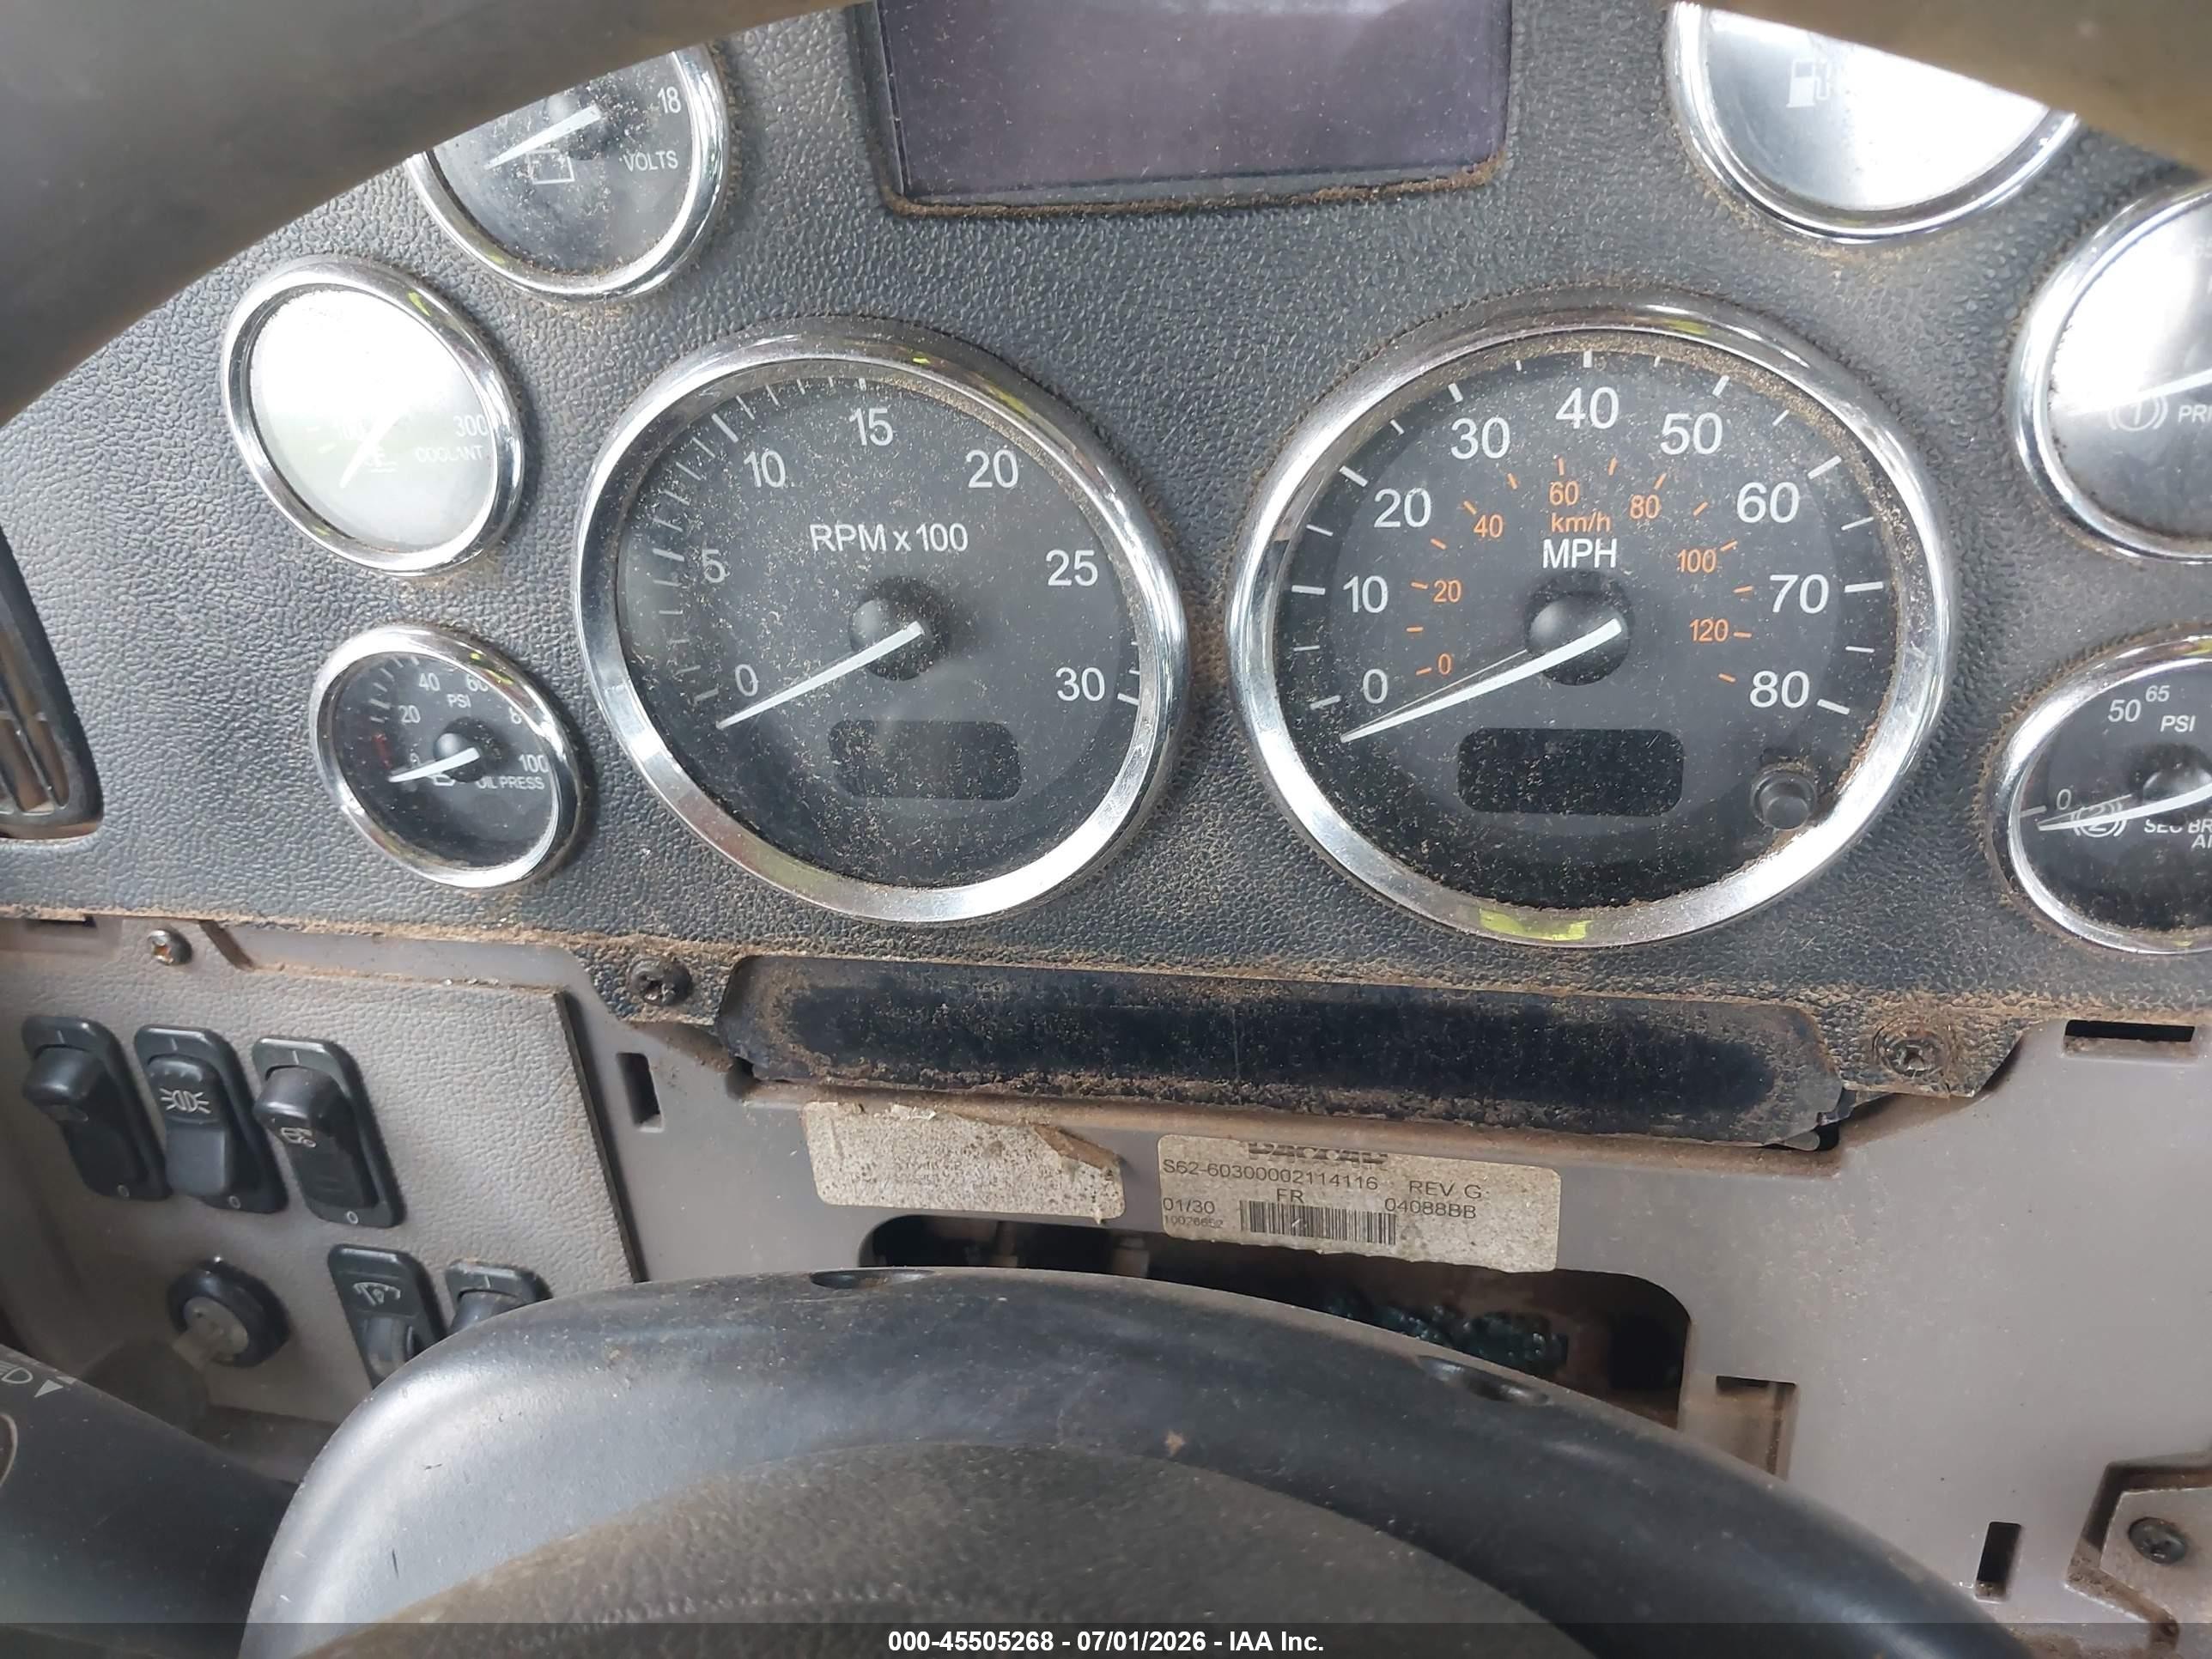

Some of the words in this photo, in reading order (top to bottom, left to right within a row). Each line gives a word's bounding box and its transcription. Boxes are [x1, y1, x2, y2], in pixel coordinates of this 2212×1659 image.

[658, 86, 681, 113] 18
[623, 149, 678, 172] VOLTS
[1555, 386, 1620, 429] 40
[453, 415, 489, 437] 300
[849, 407, 894, 447] 15
[1450, 416, 1510, 459] 30
[1660, 412, 1723, 455] 50
[415, 445, 483, 463] COOLANT
[744, 450, 787, 488] 10
[966, 449, 1018, 489] 20
[1549, 481, 1579, 506] 60
[1737, 482, 1800, 523] 60
[1374, 488, 1431, 527] 20
[1630, 495, 1661, 520] 80
[1473, 514, 1504, 538] 40
[1551, 511, 1611, 533] km/h
[810, 523, 886, 551] RPM
[895, 530, 912, 551] x
[915, 523, 968, 551] 100
[1543, 538, 1617, 568] MPH
[1677, 549, 1717, 573] 100
[702, 549, 726, 583] 5
[1045, 549, 1098, 586] 25
[1343, 575, 1388, 613] 10
[1432, 580, 1462, 603] 20
[1769, 574, 1829, 614] 70
[1689, 618, 1729, 642] 120
[1437, 653, 1452, 675] 0
[418, 672, 441, 691] 40
[734, 664, 758, 697] 0
[1055, 667, 1105, 702] 30
[1363, 669, 1388, 704] 0
[1749, 671, 1809, 708] 80
[447, 694, 471, 708] PSI
[2145, 685, 2170, 702] 65
[398, 705, 421, 723] 20
[2108, 699, 2141, 722] 50
[2160, 715, 2196, 732] PSI
[518, 754, 549, 773] 100
[500, 776, 544, 790] PRESS
[2057, 788, 2072, 810] 0
[1163, 1159, 1378, 1190] S62-60300002114116
[1409, 1181, 1455, 1197] REV
[1464, 1184, 1482, 1200] G
[1164, 1197, 1215, 1214] 01/30
[1276, 1188, 1304, 1203] FR
